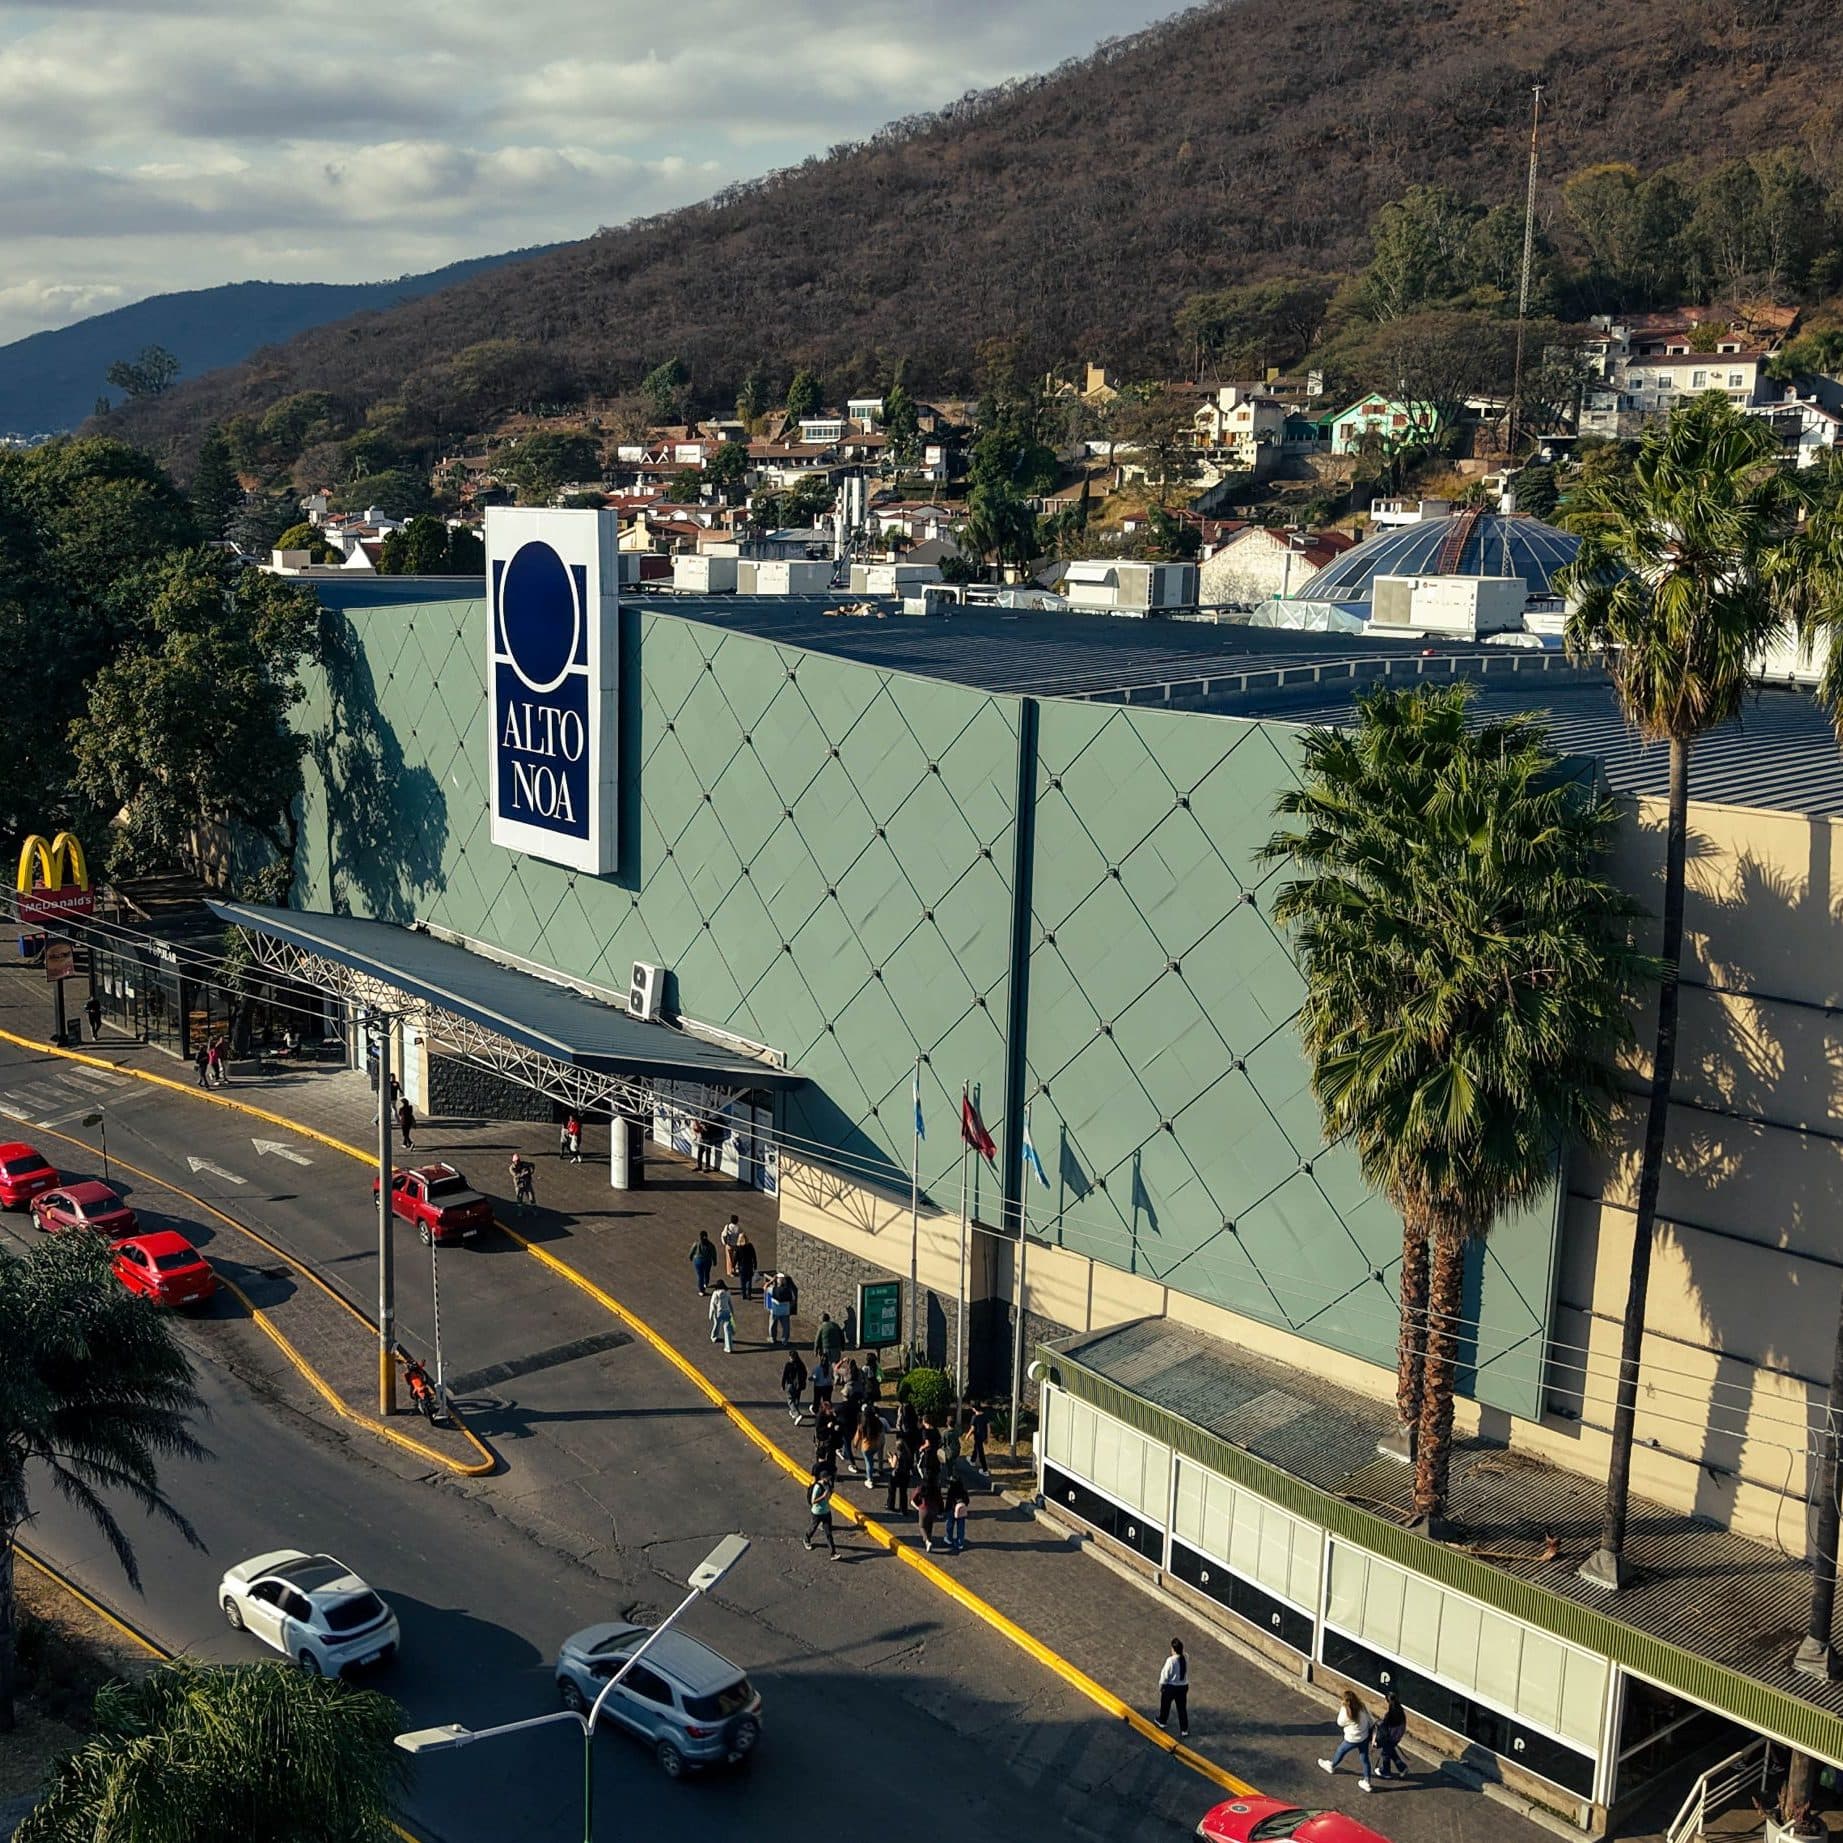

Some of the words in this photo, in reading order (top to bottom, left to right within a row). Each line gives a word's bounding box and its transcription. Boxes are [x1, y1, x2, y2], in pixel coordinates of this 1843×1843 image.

[502, 700, 584, 762] ALTO
[511, 760, 577, 823] NOA
[25, 896, 92, 912] McDonald's
